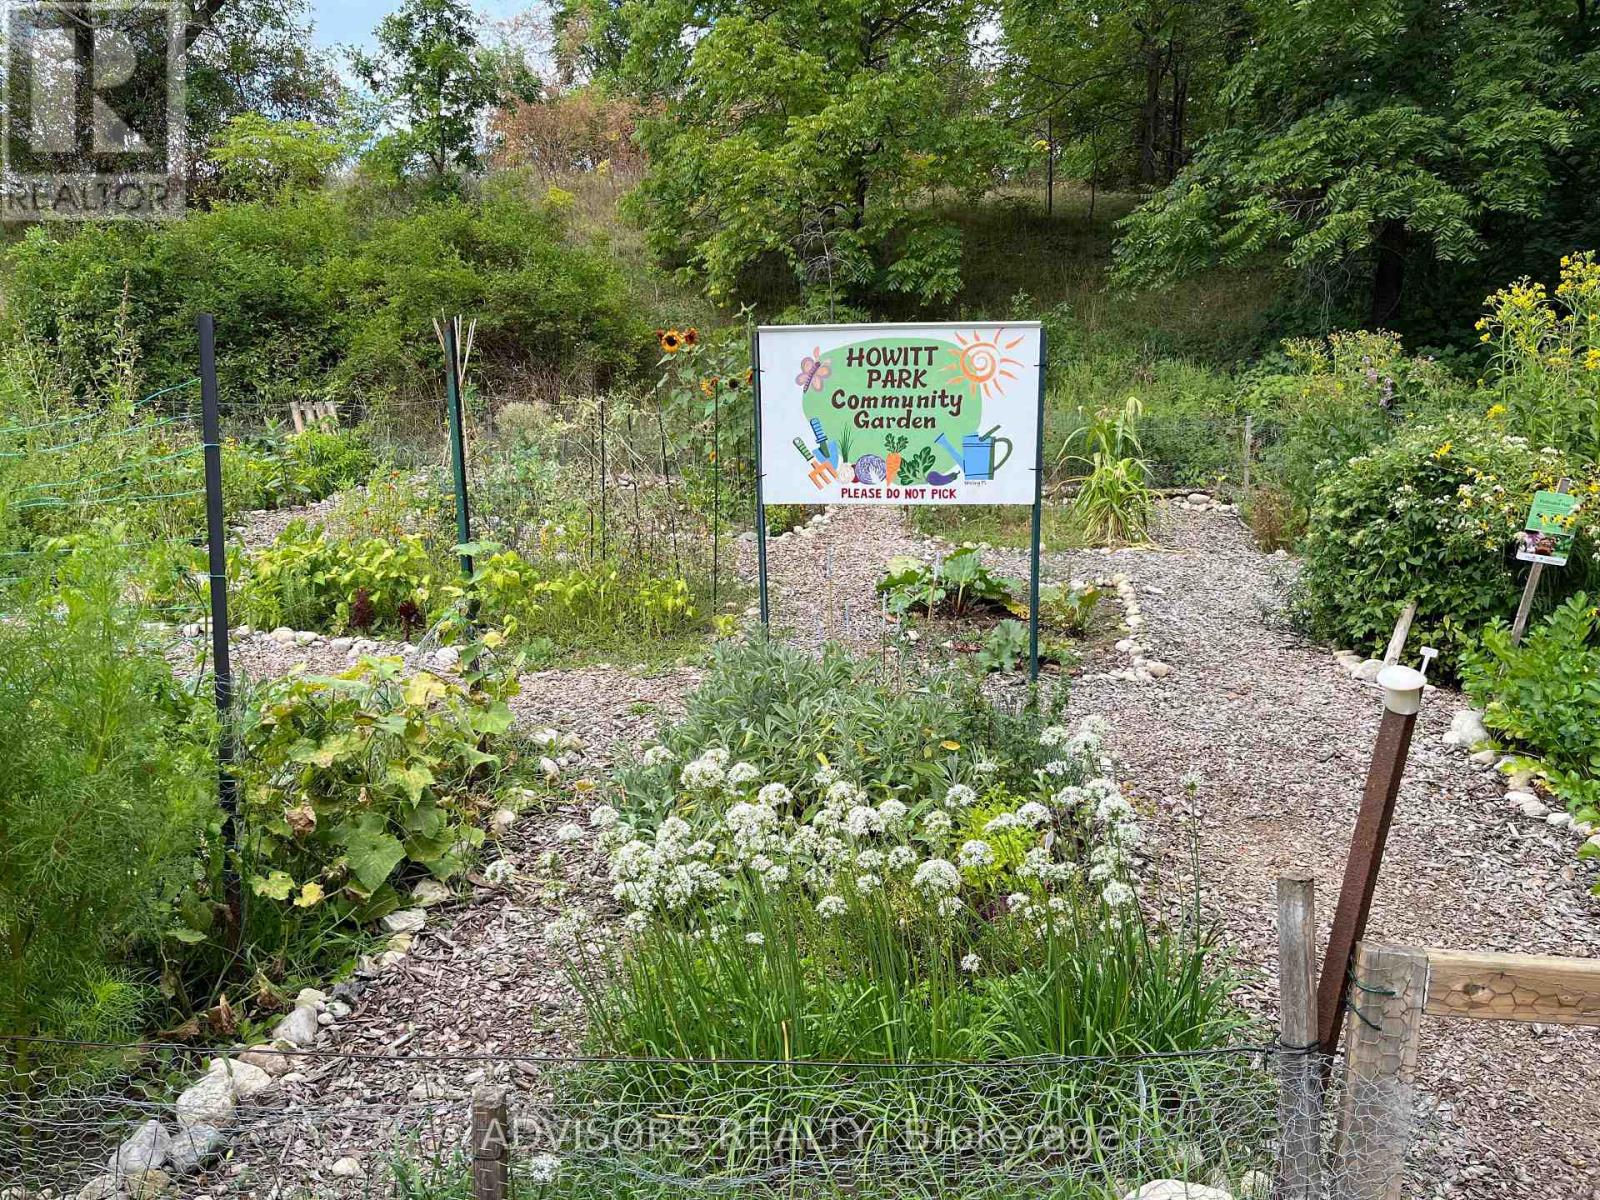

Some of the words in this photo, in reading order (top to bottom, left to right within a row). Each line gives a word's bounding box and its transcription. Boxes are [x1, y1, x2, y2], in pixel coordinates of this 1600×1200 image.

[846, 345, 939, 368] HOWITT
[867, 369, 928, 389] PARK
[831, 389, 963, 416] Community
[853, 410, 936, 429] Garden
[841, 487, 882, 499] PLEASE
[886, 487, 901, 499] DO
[904, 488, 926, 499] NOT
[931, 488, 957, 499] PICK
